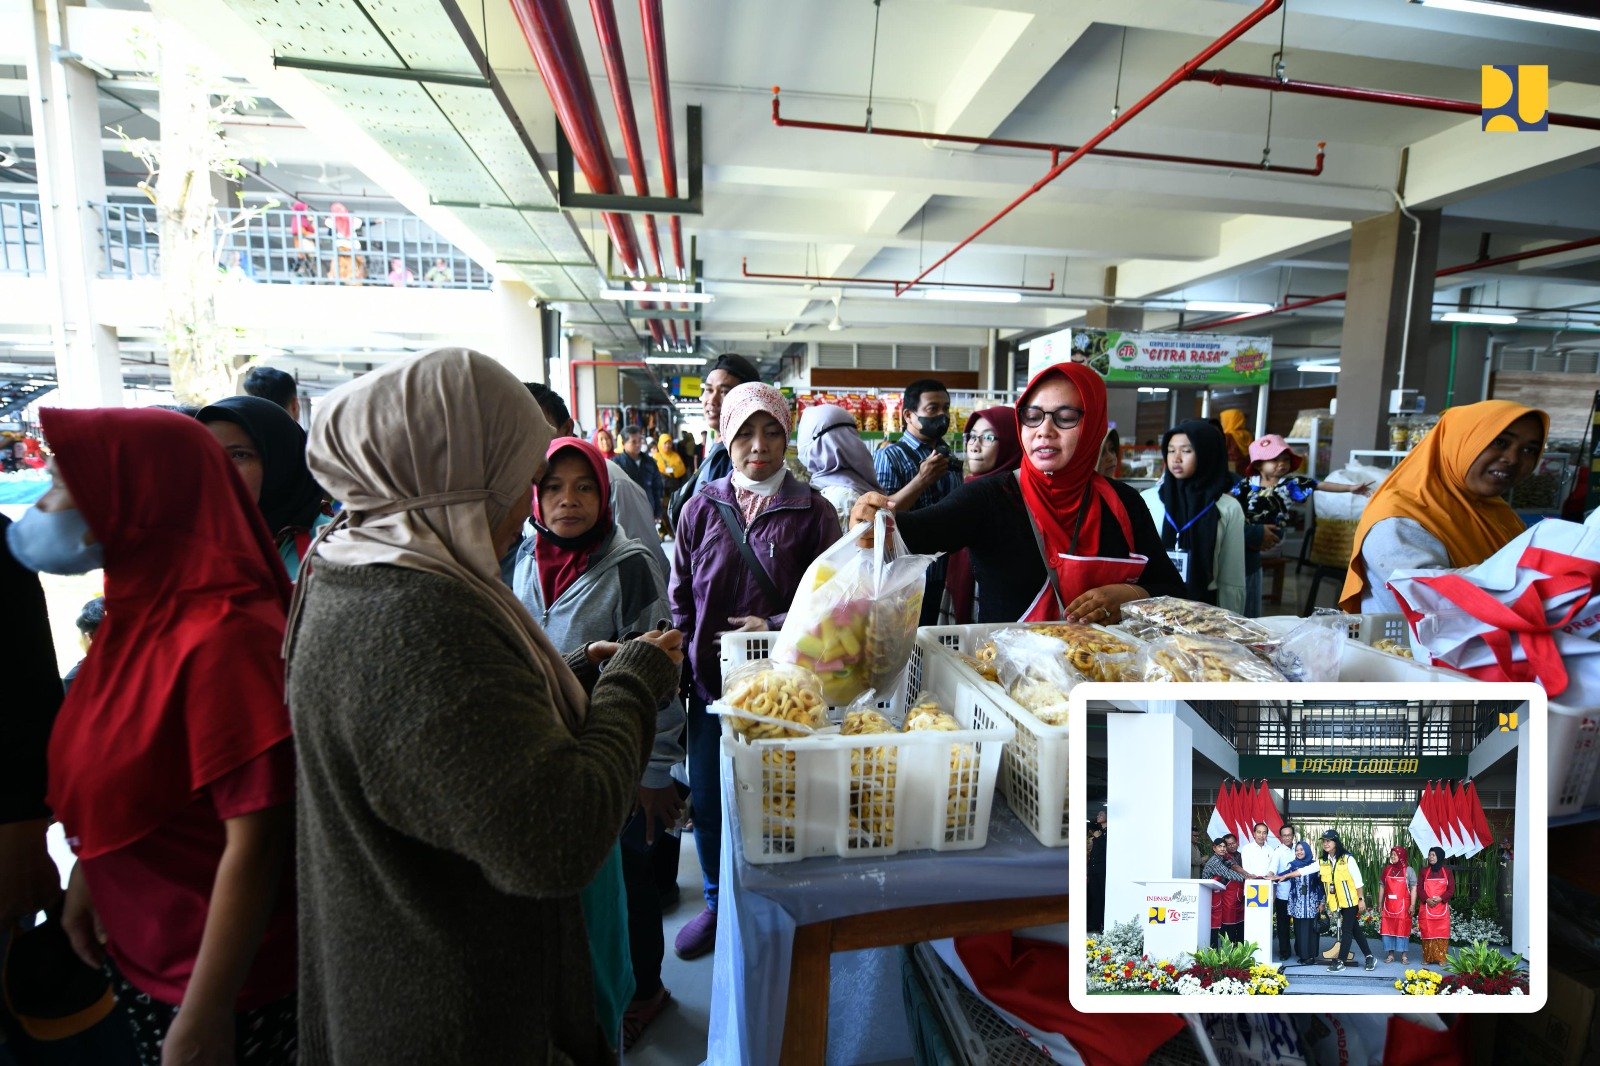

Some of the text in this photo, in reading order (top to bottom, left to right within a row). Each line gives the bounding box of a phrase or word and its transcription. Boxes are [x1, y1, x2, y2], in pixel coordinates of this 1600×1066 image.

[1118, 345, 1136, 358] CTR
[1302, 758, 1419, 774] PASAR GODEAN
